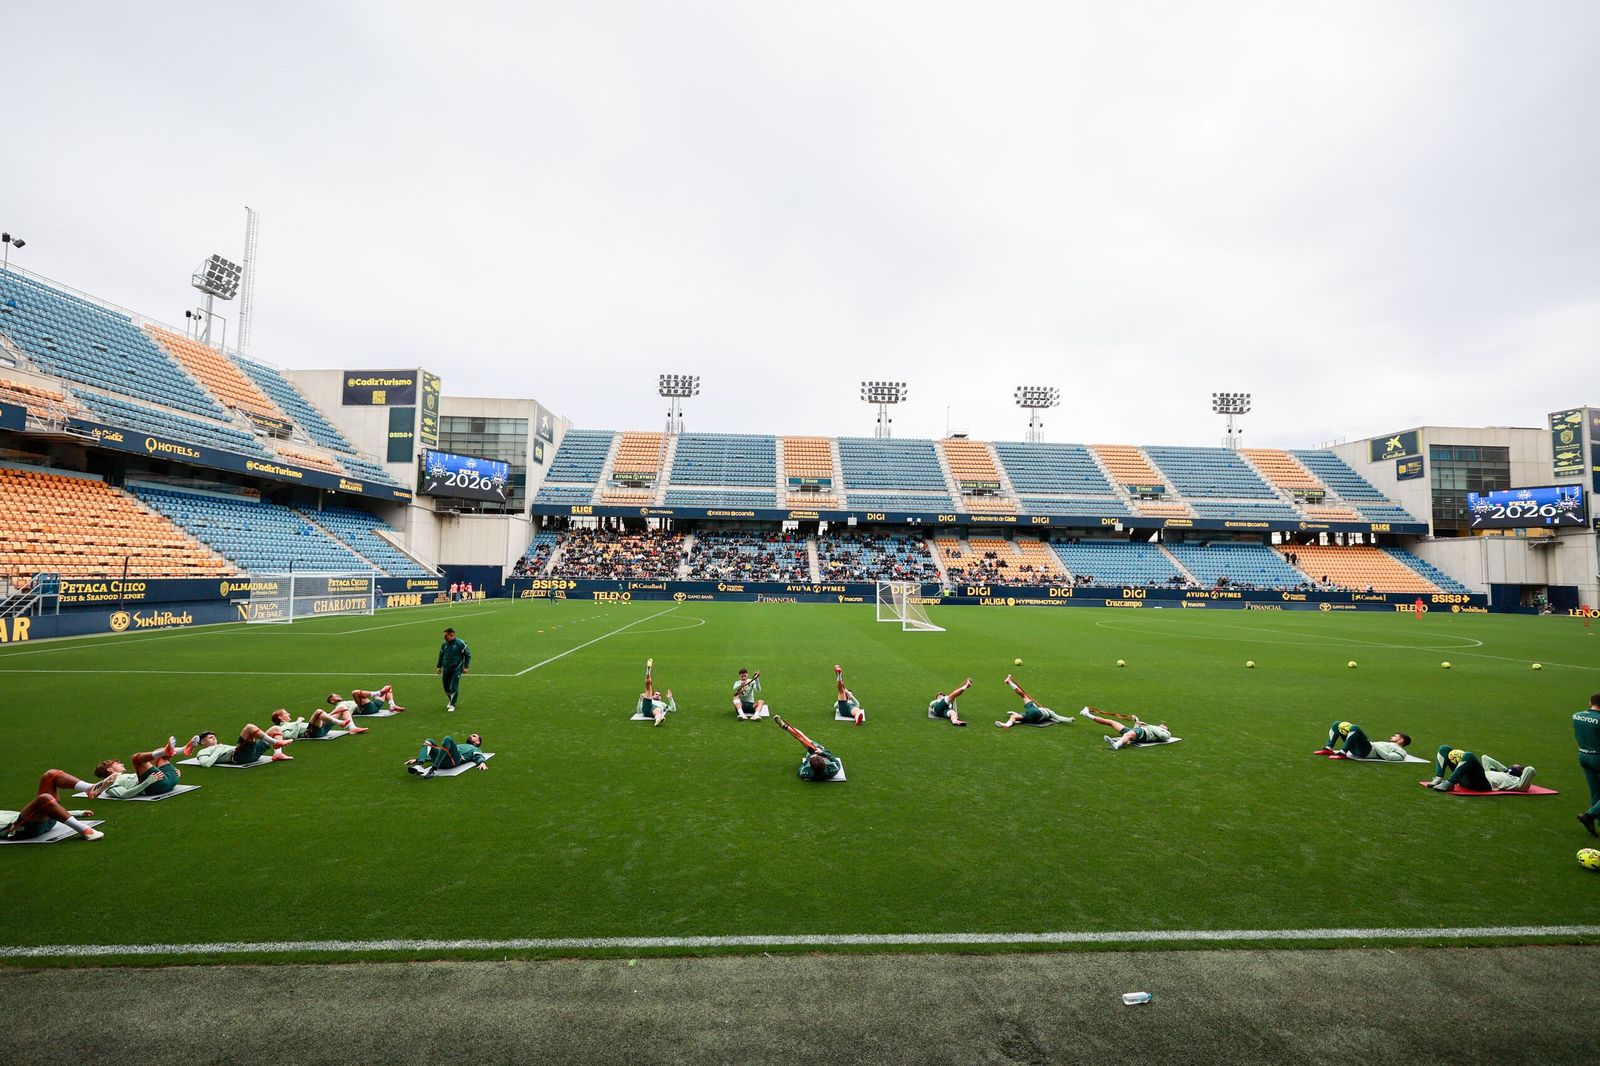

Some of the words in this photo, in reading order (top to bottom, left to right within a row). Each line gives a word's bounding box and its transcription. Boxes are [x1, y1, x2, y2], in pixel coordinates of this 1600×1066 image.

[348, 378, 412, 387] @CadizTurismo
[246, 460, 303, 479] @CadizTurismo
[445, 471, 492, 490] 2026
[571, 506, 593, 514] SLICE
[1490, 504, 1557, 519] 2026
[60, 581, 108, 593] PETACA
[230, 582, 278, 591] ALMADRABA
[533, 580, 567, 589] asisa
[967, 587, 991, 595] DIGI
[1049, 588, 1073, 597] DIGI
[1123, 589, 1146, 598] DIGI
[86, 593, 118, 601] SEAFOOD
[1431, 594, 1462, 603] asisa
[314, 598, 367, 613] CHARLOTTE
[1105, 599, 1143, 608] Cruzcampo
[132, 610, 193, 628] SushiPanda
